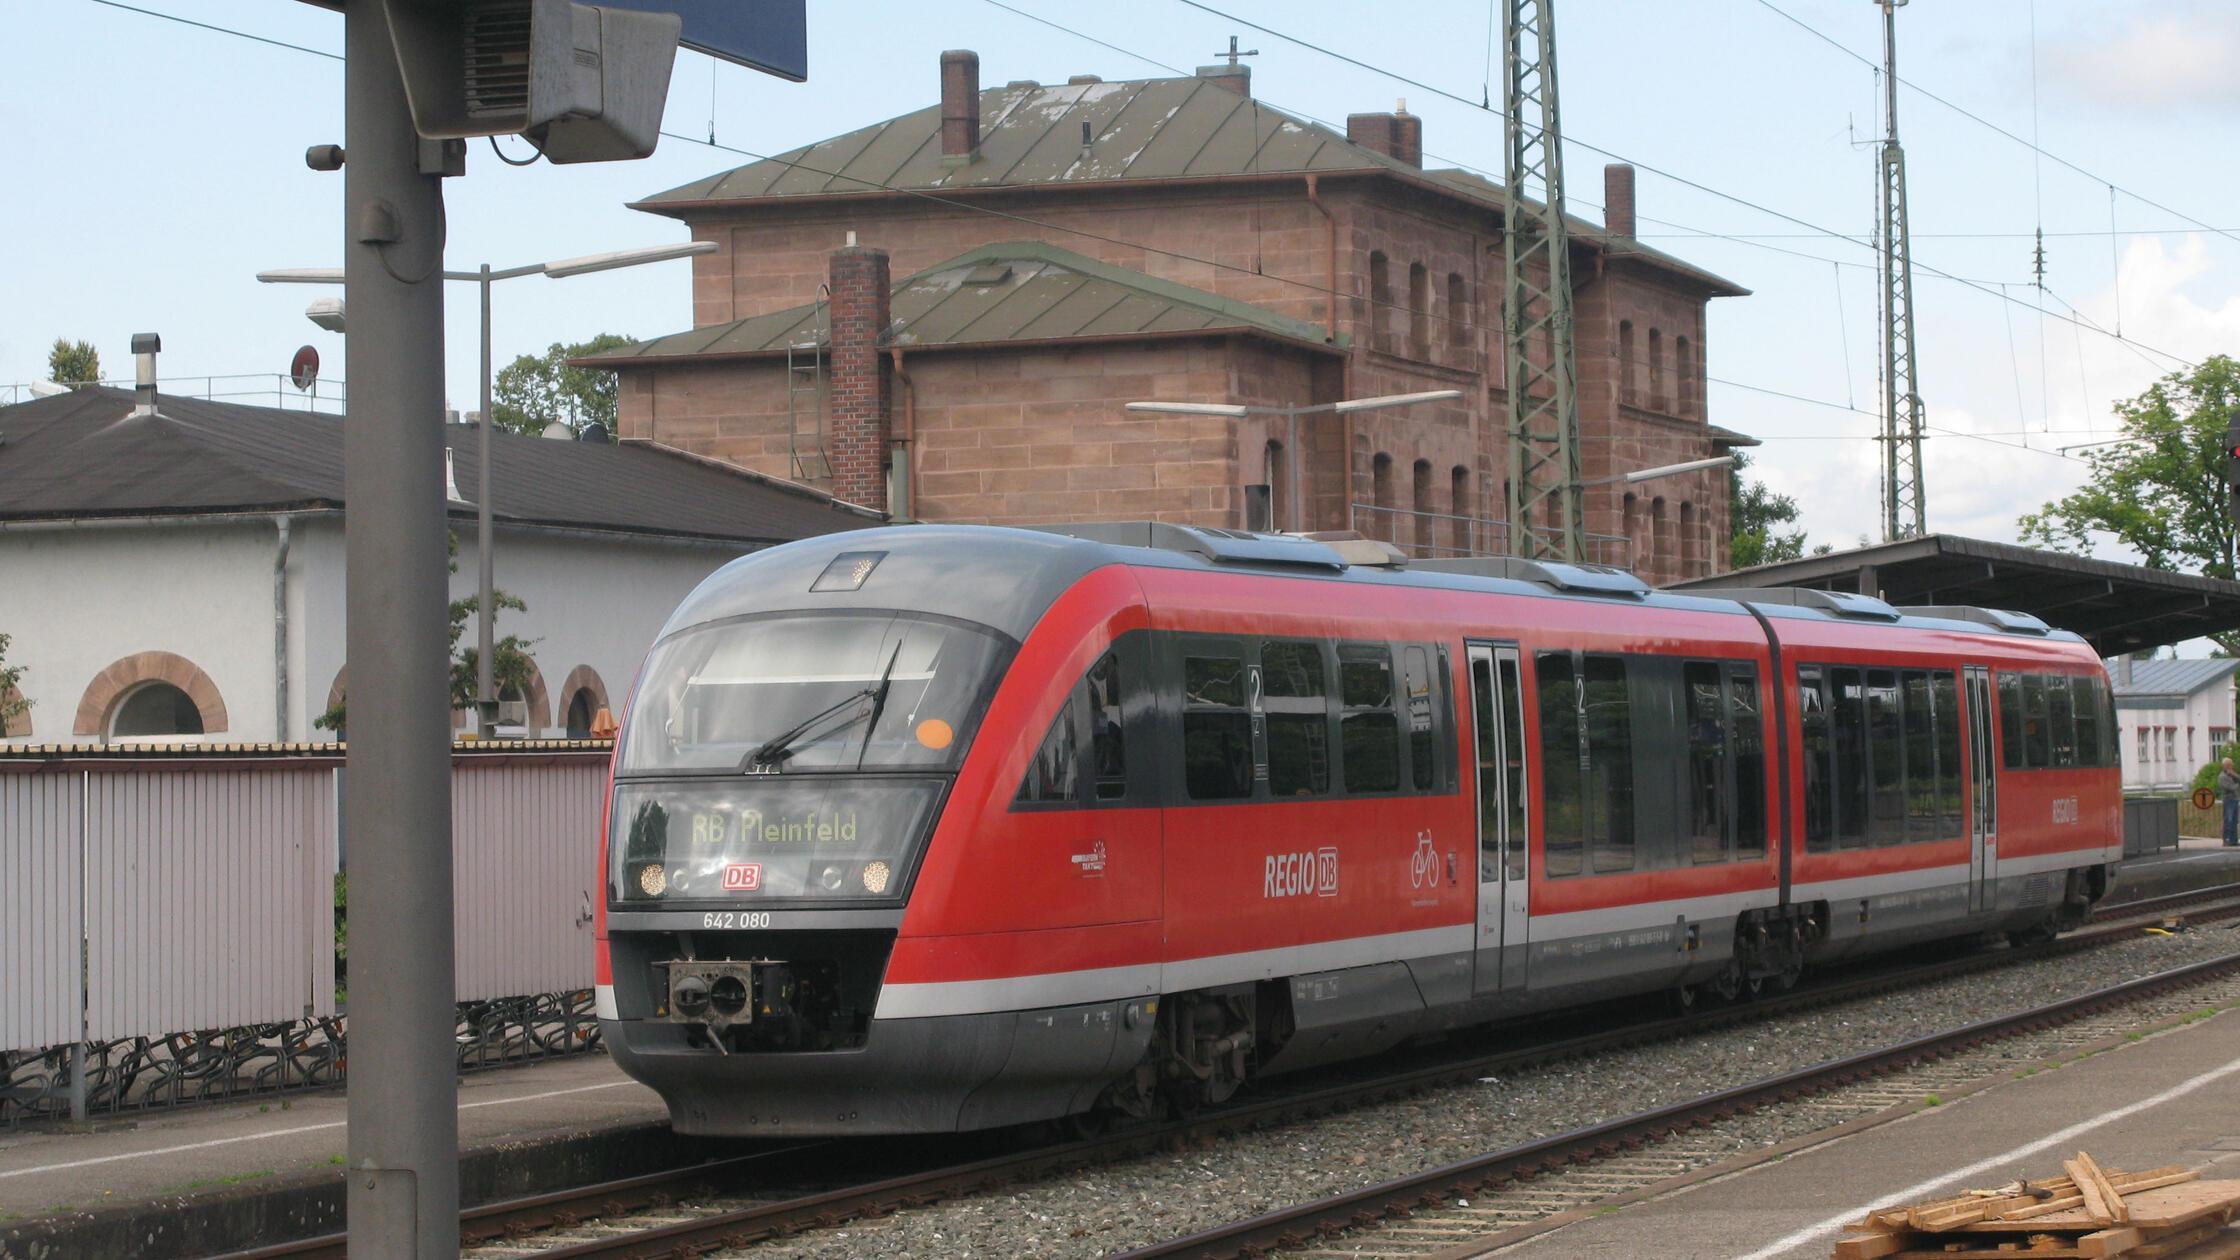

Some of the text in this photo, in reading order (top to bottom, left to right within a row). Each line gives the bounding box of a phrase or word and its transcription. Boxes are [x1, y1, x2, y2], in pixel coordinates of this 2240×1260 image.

[1251, 669, 1263, 713] 2
[1577, 678, 1586, 713] 2
[693, 811, 856, 842] RB Pleinfeld
[725, 867, 758, 886] DB
[1264, 851, 1337, 898] REGIO DB
[703, 912, 770, 929] 642 080
